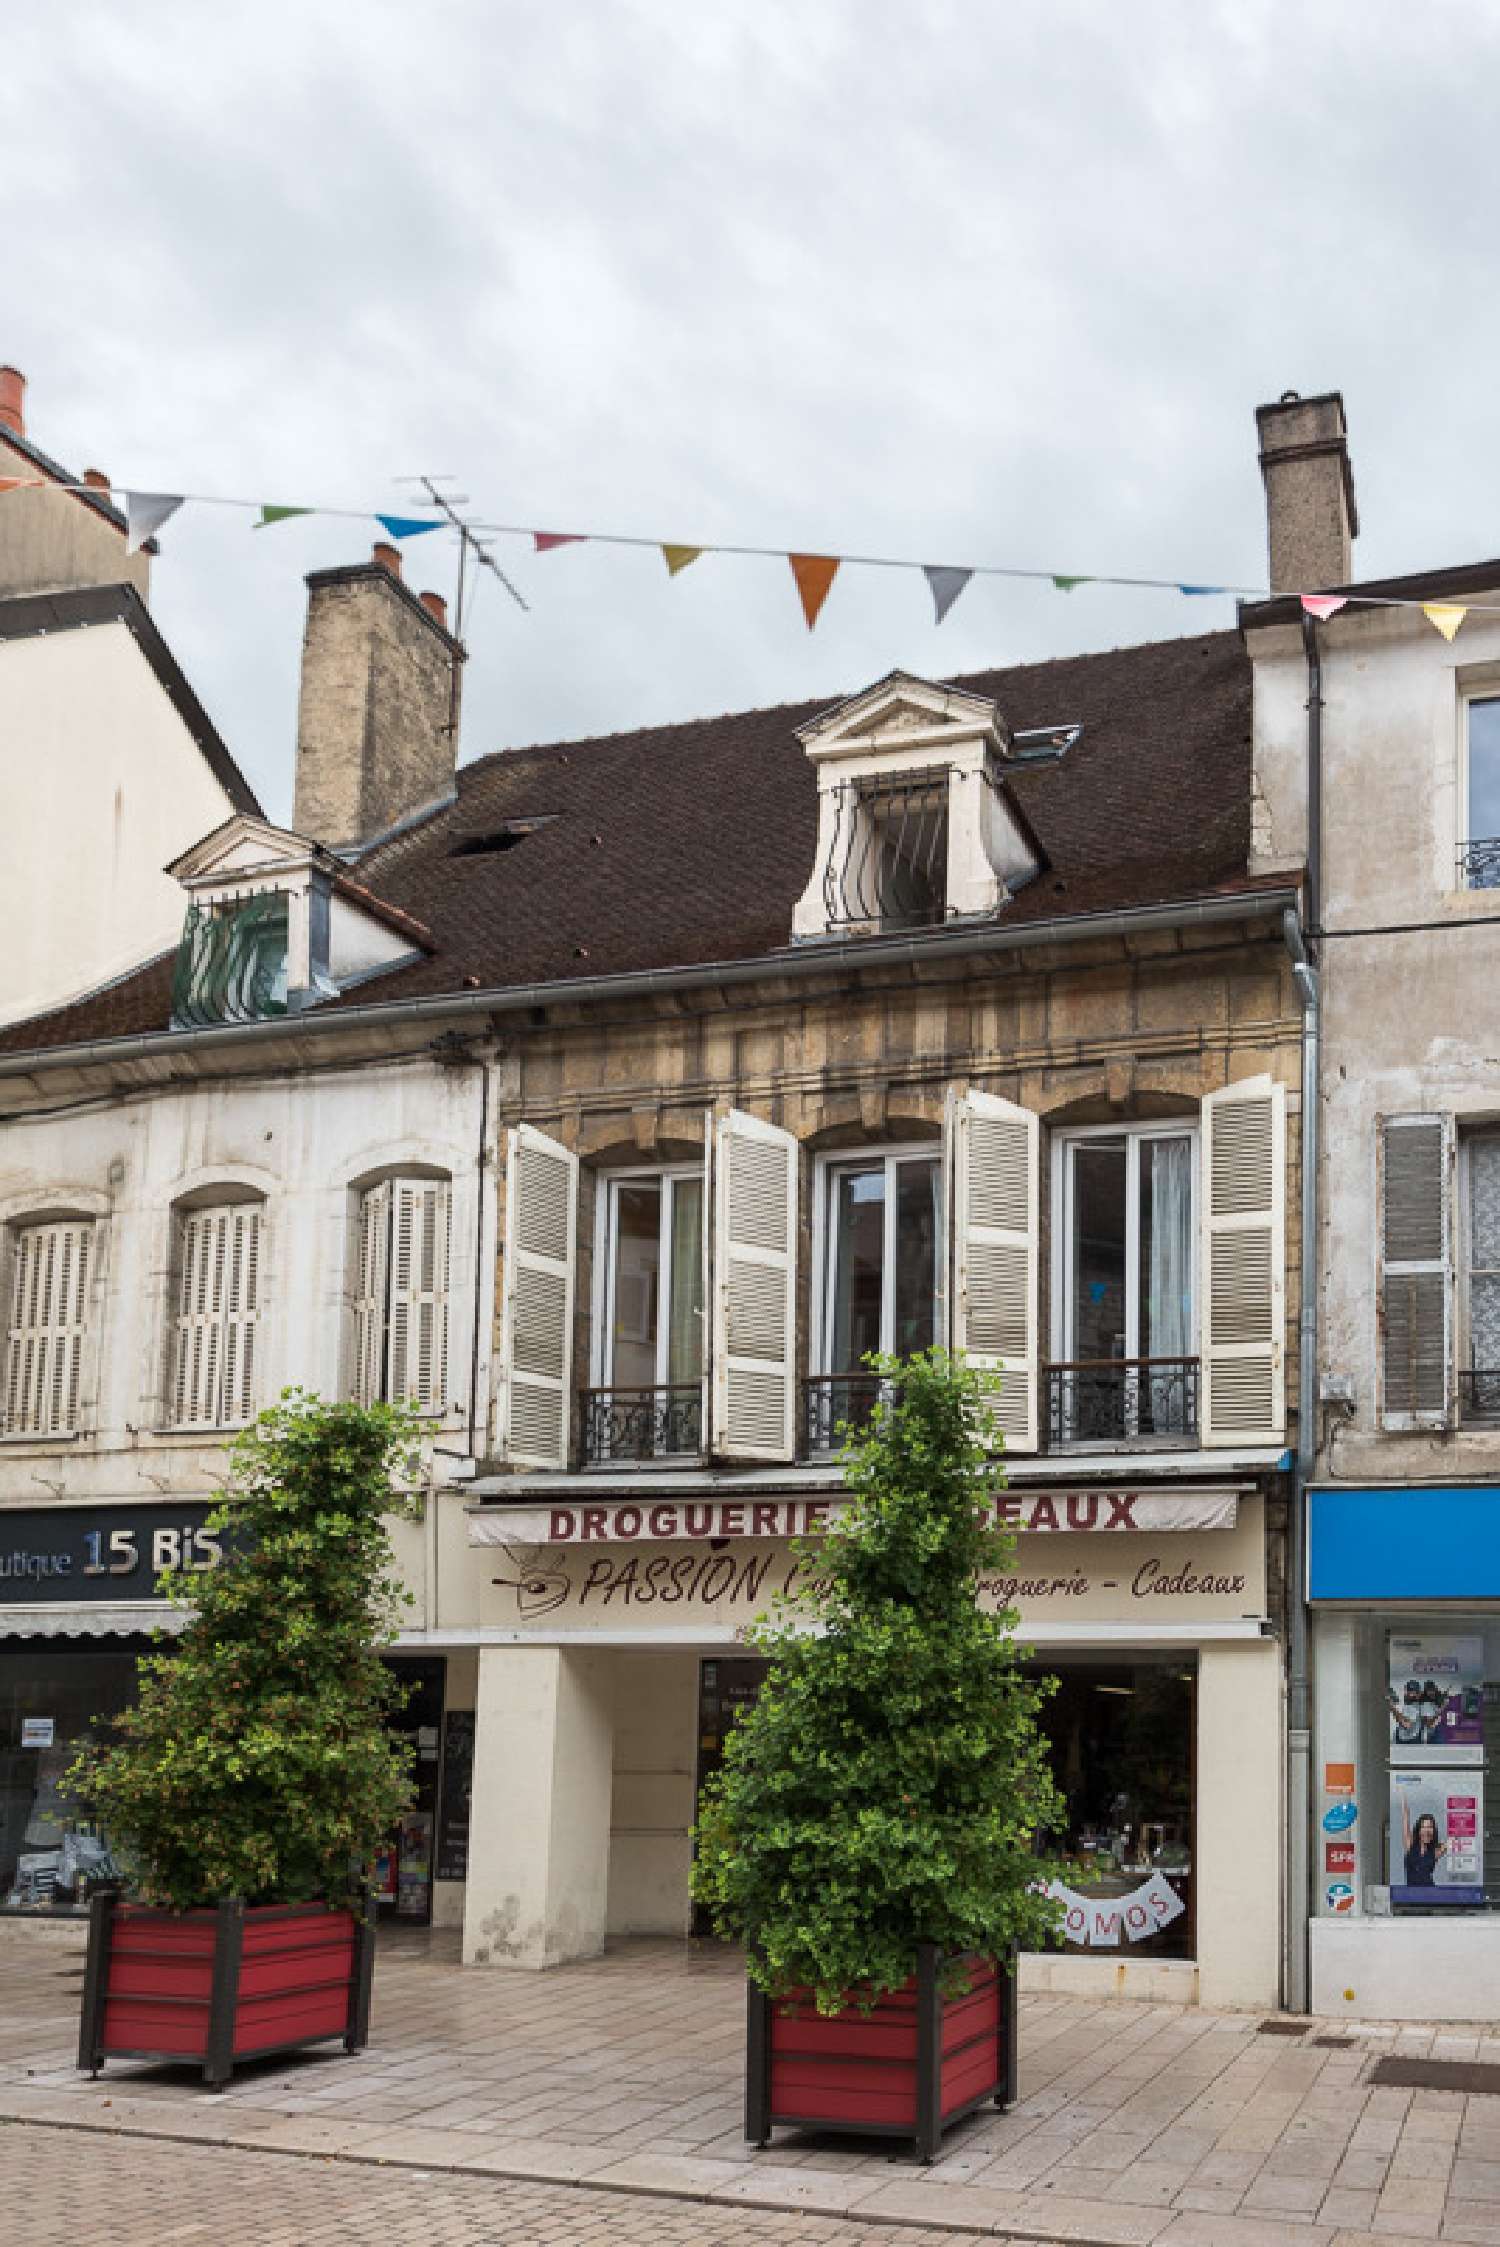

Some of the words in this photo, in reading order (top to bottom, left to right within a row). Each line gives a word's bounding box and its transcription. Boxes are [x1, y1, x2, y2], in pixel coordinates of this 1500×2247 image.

[549, 1502, 831, 1540] DROGUERIE
[82, 1530, 139, 1574] 15
[578, 1552, 774, 1605] PASSION
[973, 1568, 1090, 1610] roguerie
[1131, 1558, 1247, 1598] Cadeaux
